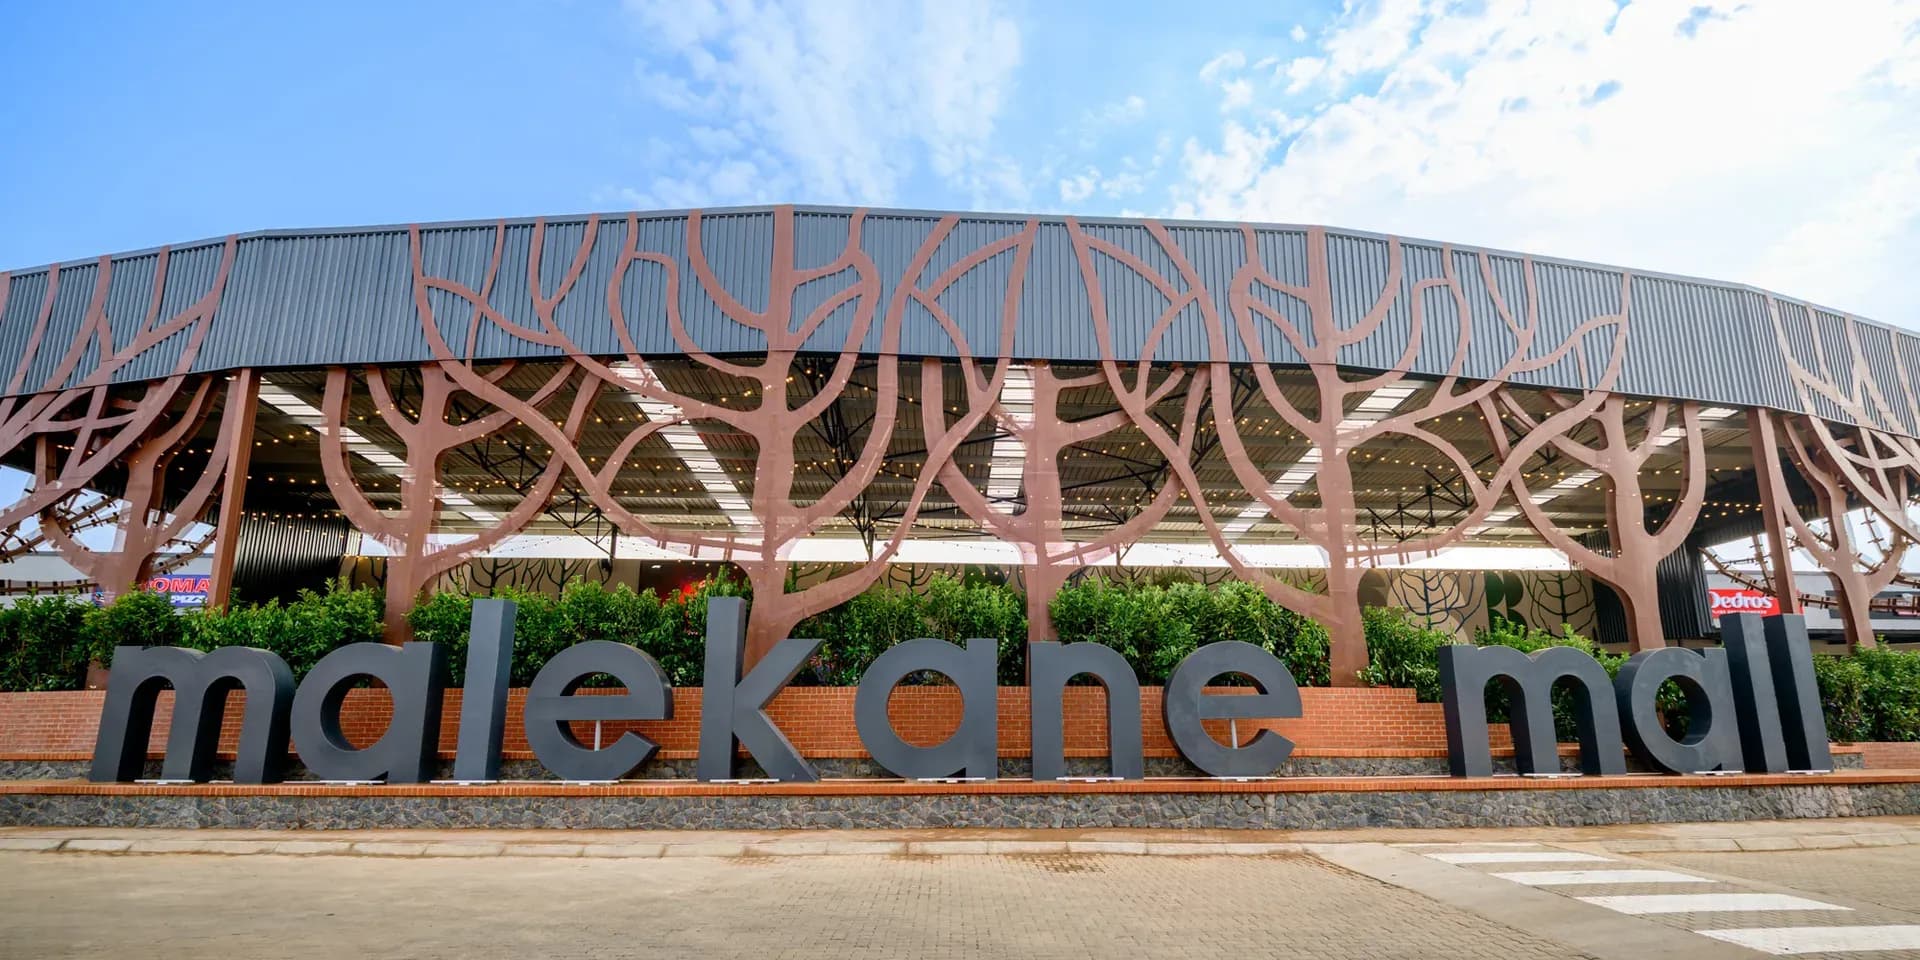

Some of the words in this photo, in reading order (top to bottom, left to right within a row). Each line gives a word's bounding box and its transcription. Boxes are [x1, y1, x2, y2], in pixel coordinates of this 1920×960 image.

[147, 577, 209, 593] OMA
[90, 597, 1303, 782] malekane
[1438, 613, 1832, 777] mall
